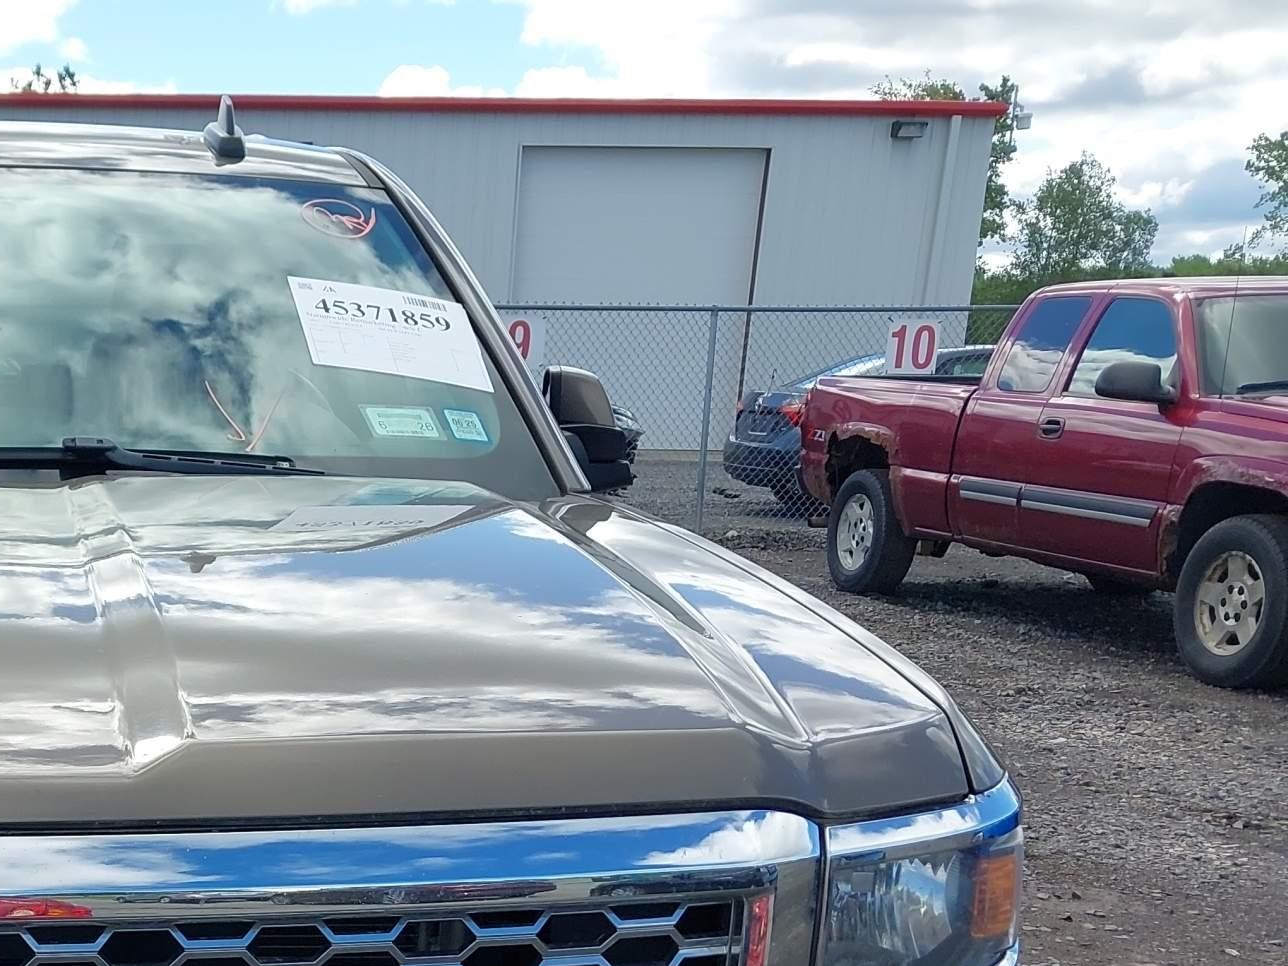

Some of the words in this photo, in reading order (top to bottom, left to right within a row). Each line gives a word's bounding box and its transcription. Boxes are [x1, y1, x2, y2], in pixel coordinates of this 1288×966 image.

[314, 298, 451, 332] 45371859
[508, 319, 531, 361] 9
[891, 324, 936, 370] 10
